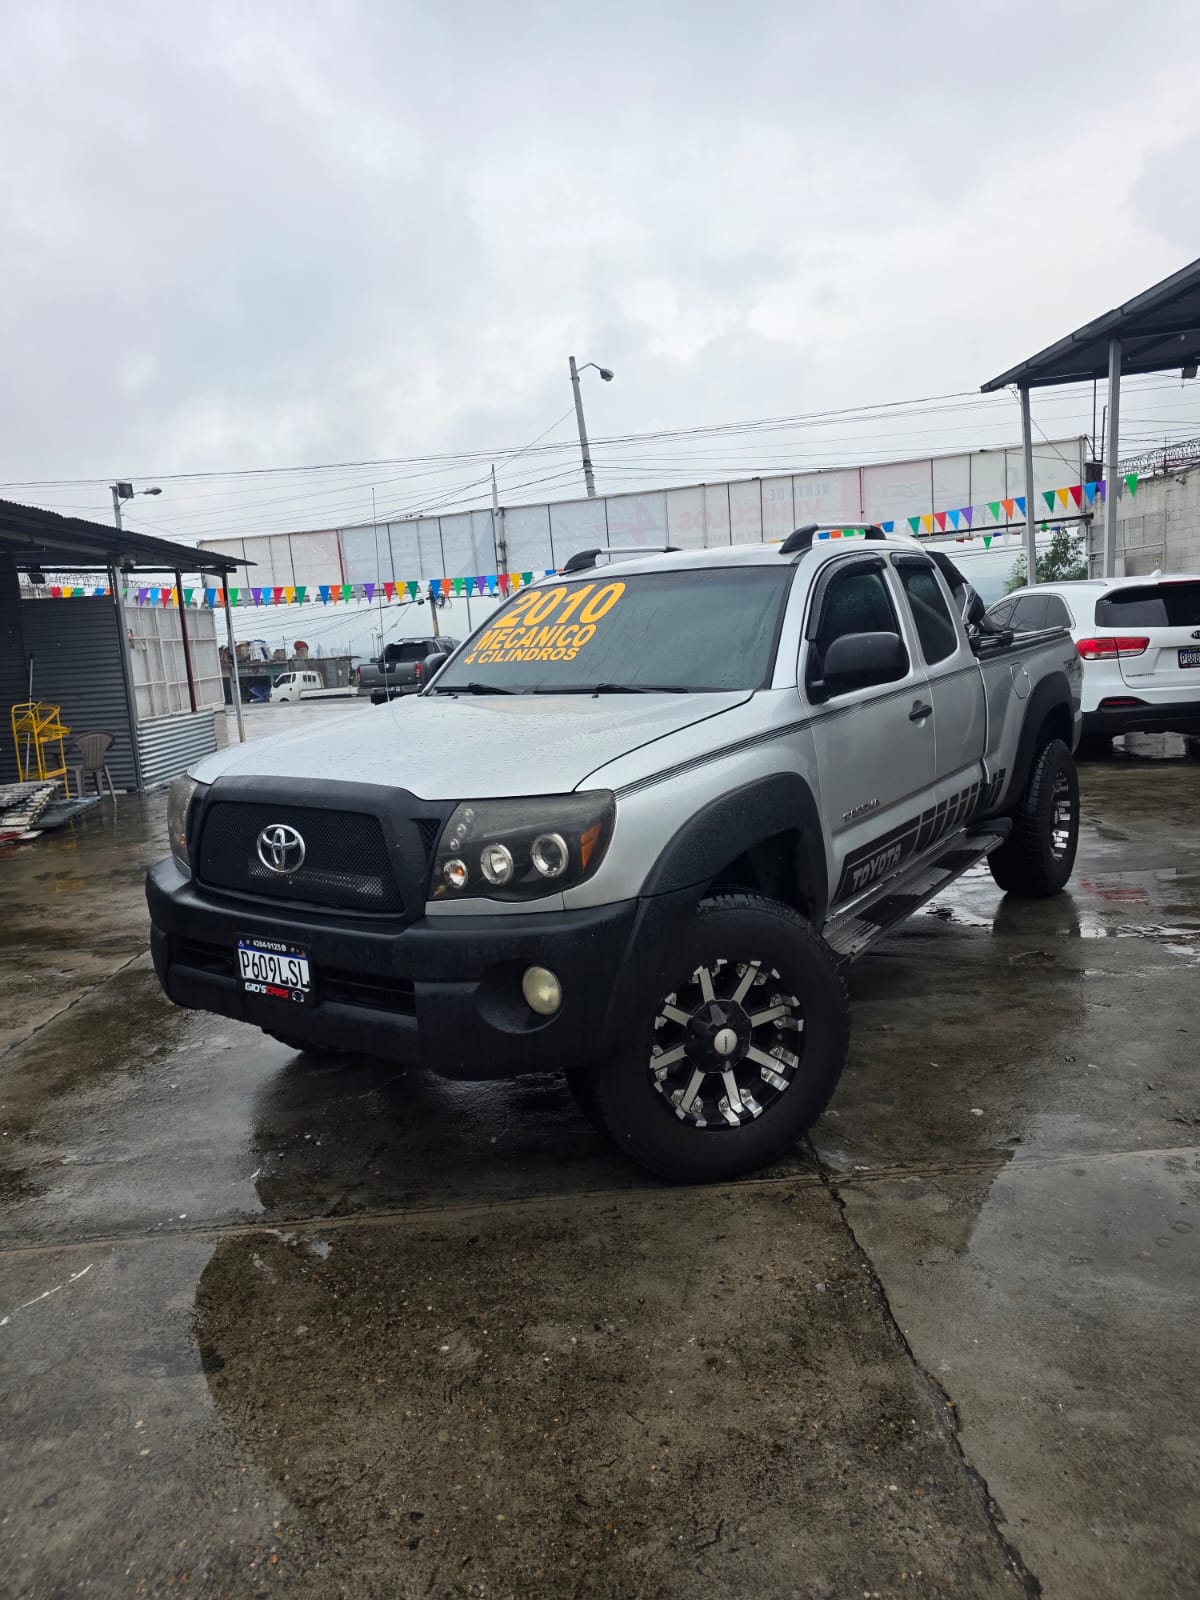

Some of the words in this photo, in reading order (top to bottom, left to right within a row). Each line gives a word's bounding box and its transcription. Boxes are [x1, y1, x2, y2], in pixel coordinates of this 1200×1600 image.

[492, 583, 625, 628] 2010
[464, 651, 478, 664] 4
[478, 648, 580, 664] CILINDROS
[474, 625, 595, 651] MECANICO
[853, 845, 902, 891] TOYOTA
[241, 951, 310, 987] P609LSL
